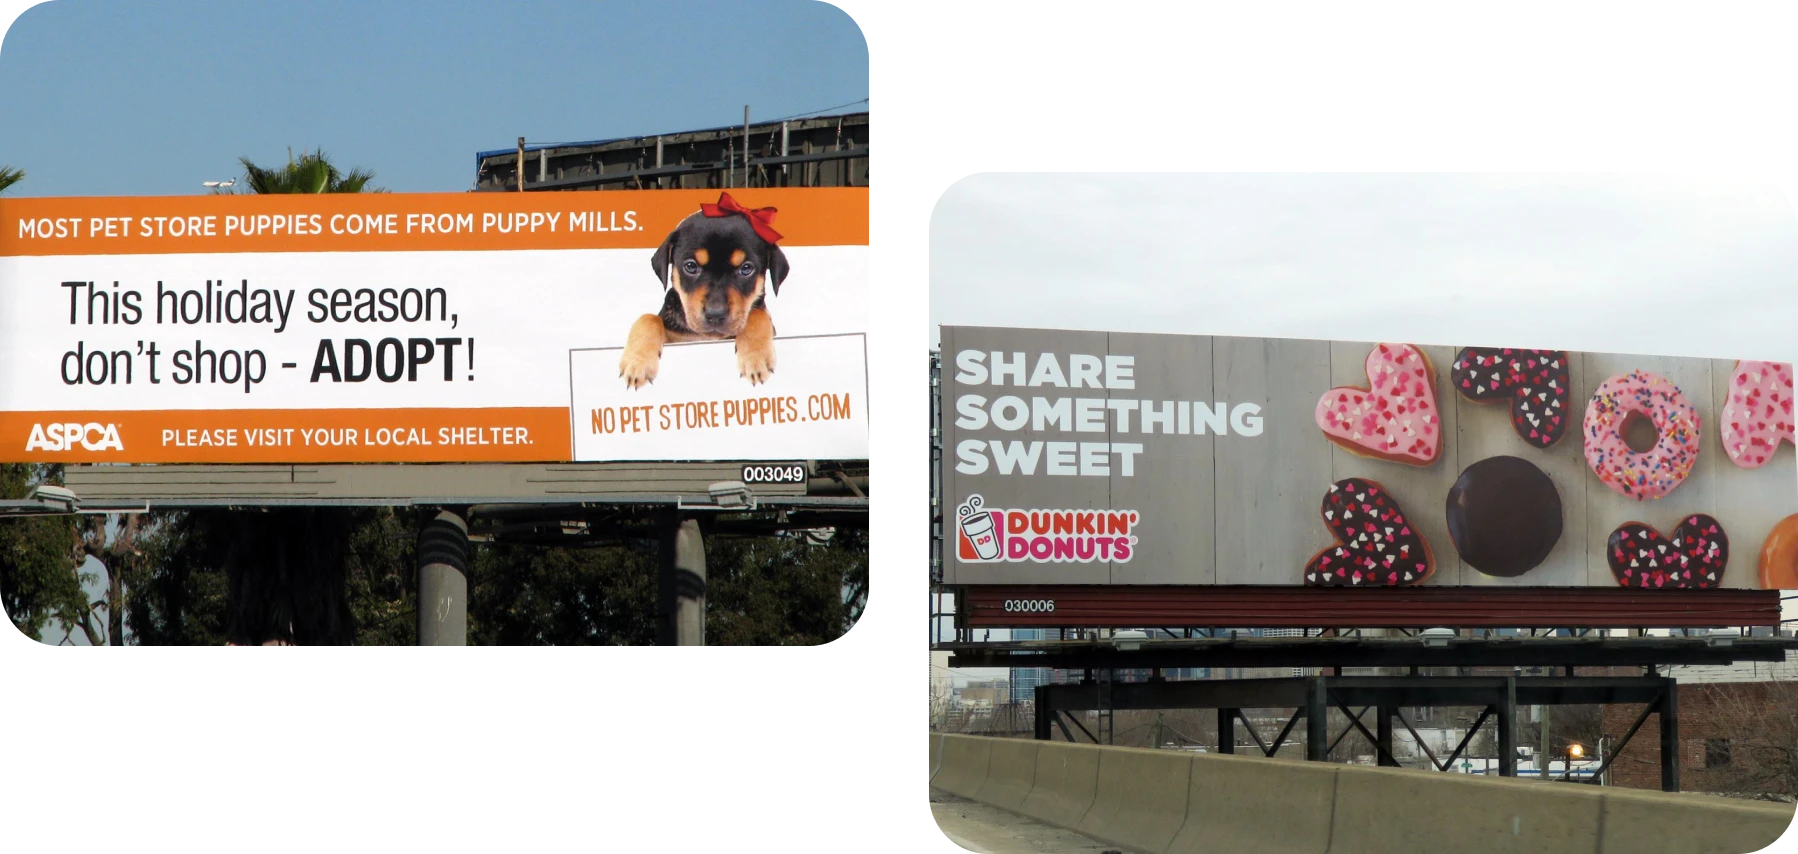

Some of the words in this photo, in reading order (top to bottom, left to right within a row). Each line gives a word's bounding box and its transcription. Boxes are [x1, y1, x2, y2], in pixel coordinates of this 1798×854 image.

[19, 218, 82, 238] MOST
[90, 217, 132, 237] PET
[140, 216, 217, 237] STORE
[225, 214, 322, 236] PUPPIES
[330, 214, 398, 234] COME
[407, 213, 473, 234] FROM
[482, 212, 561, 233] PUPPY
[569, 211, 643, 233] MILLS.
[61, 280, 142, 325] This
[157, 279, 295, 333] holiday
[308, 286, 458, 329] season,
[61, 341, 161, 385] don't
[172, 340, 267, 393] shop
[310, 337, 475, 383] ADOPT!
[955, 350, 1135, 389] SHARE
[591, 407, 615, 434] NO
[620, 405, 653, 433] PET
[659, 401, 719, 430] STORE
[955, 395, 1264, 437] SOMETHING
[25, 422, 124, 451] ASPCA
[162, 428, 237, 446] PLEASE
[244, 428, 293, 446] VISIT
[301, 428, 357, 446] YOUR
[365, 428, 432, 445] LOCAL
[438, 427, 533, 445] SHELTER.
[955, 440, 1144, 477] SWEET
[743, 466, 803, 482] 003049
[1008, 511, 1137, 535] DUNKIN'
[1008, 536, 1130, 560] DONUTS
[1004, 599, 1055, 612] 030006
